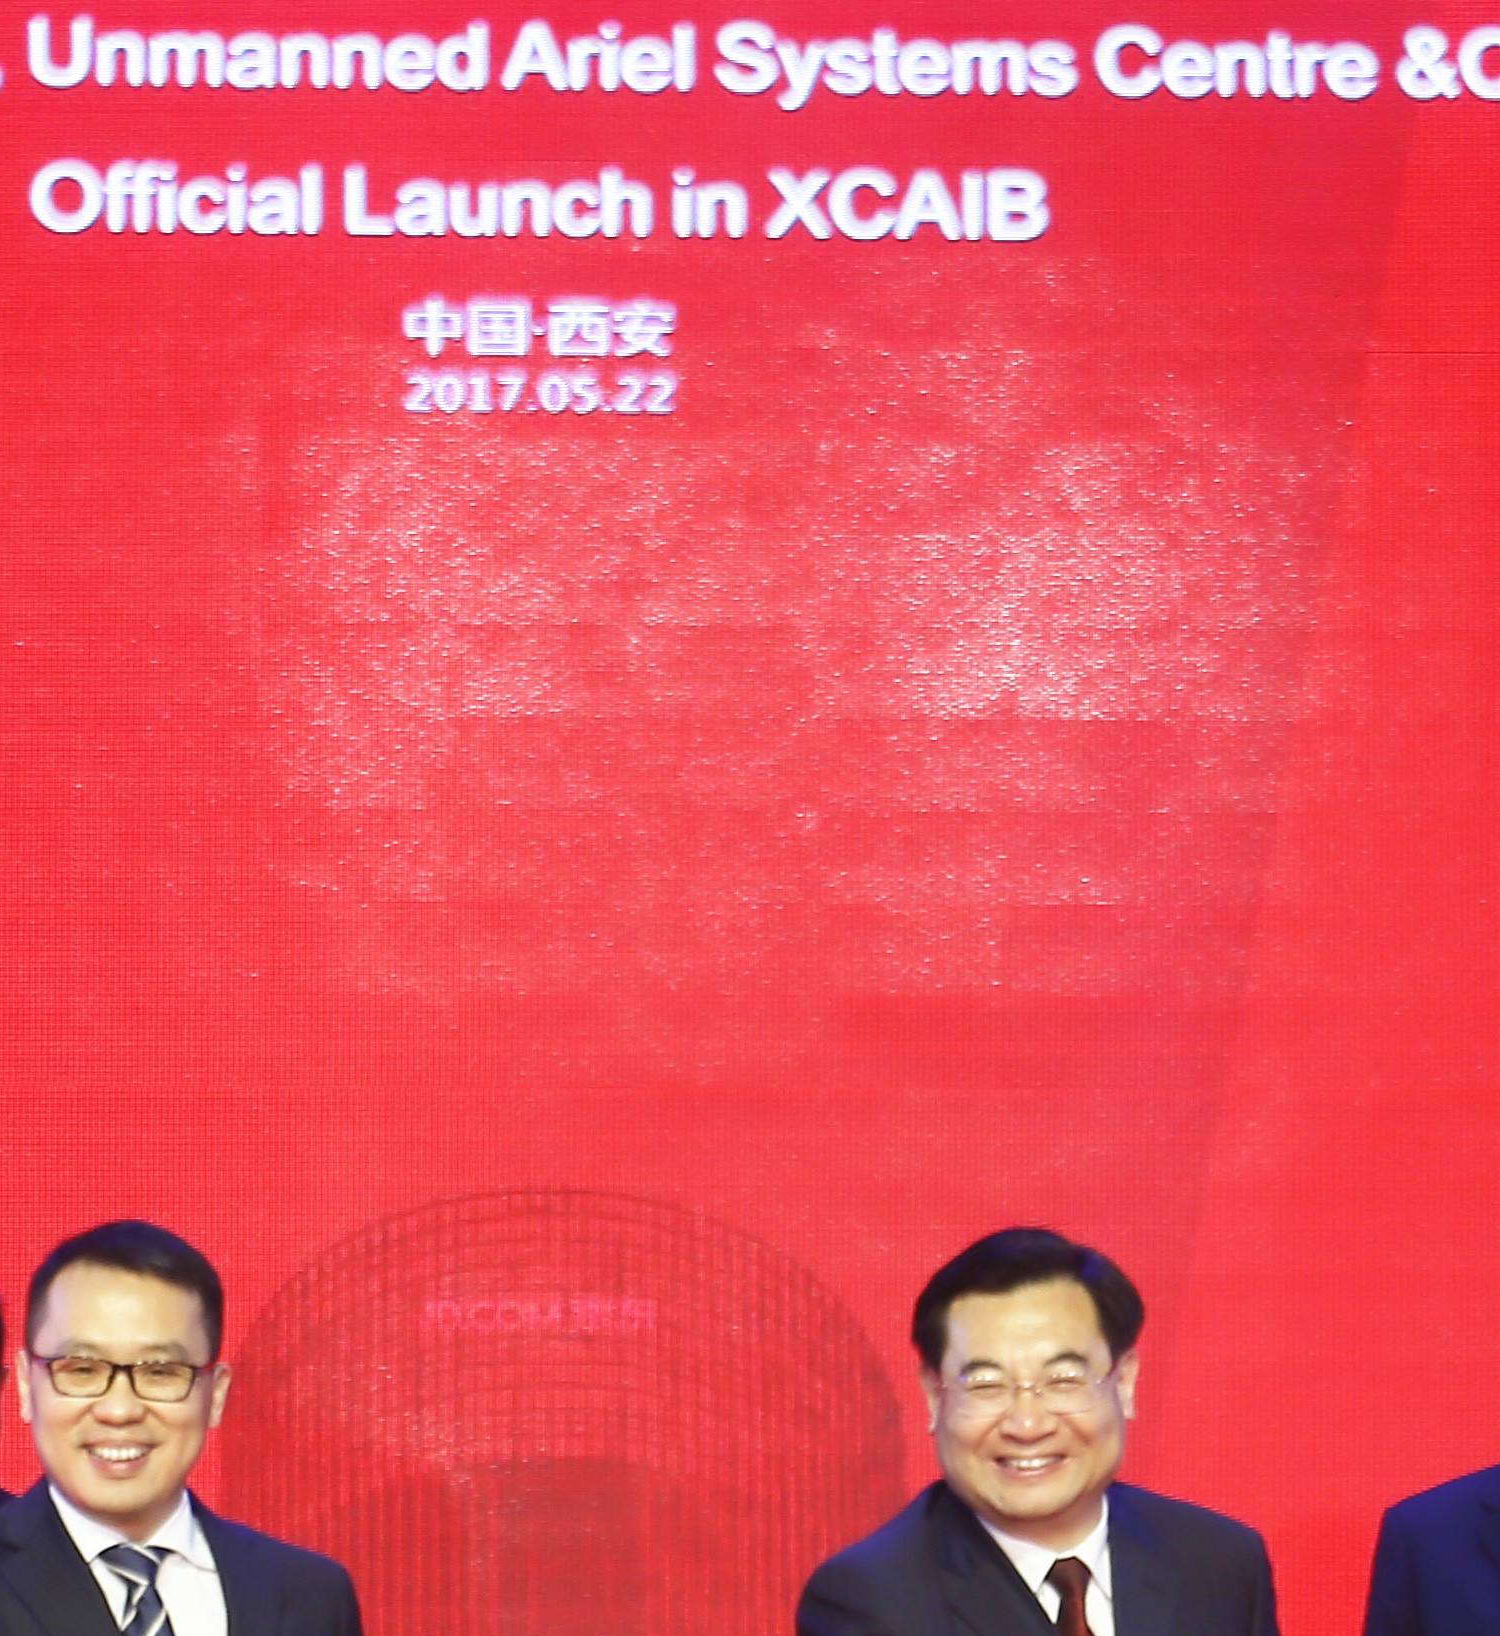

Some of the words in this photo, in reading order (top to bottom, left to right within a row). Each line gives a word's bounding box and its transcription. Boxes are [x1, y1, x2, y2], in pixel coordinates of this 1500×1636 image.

[28, 17, 489, 91] Unmanned
[501, 21, 696, 92] Ariel
[714, 21, 1078, 111] Systems
[1094, 25, 1379, 99] Centre
[29, 160, 323, 235] Official
[344, 166, 653, 238] Launch
[672, 171, 747, 238] in
[766, 168, 1049, 241] XCAIB
[404, 373, 675, 414] 2017.05.22
